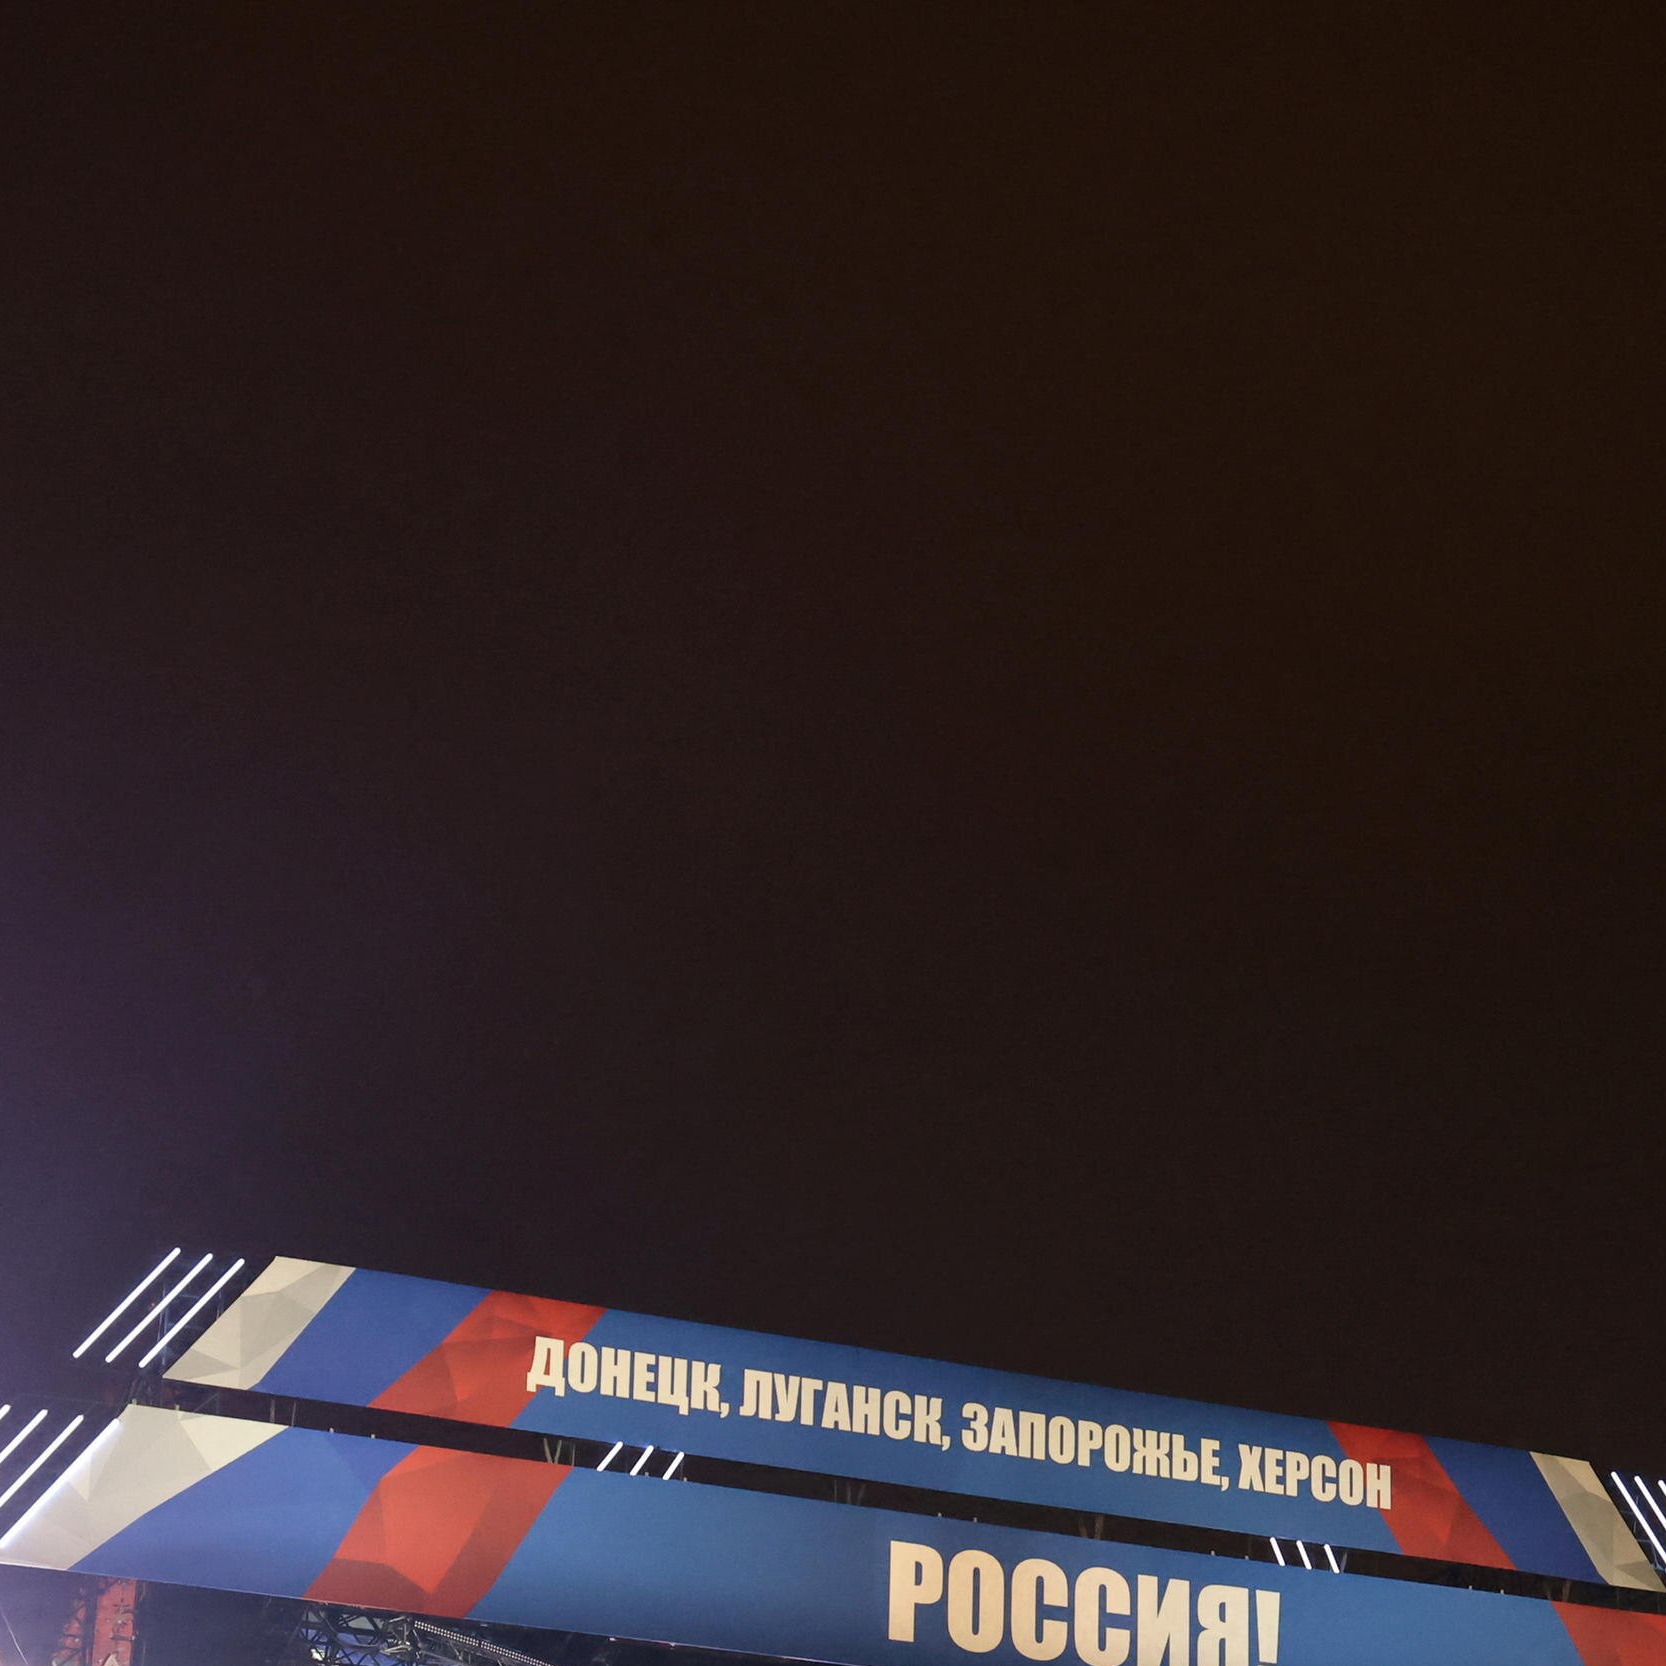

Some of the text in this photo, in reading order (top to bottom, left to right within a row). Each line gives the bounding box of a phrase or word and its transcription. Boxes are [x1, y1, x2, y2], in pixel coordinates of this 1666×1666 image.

[526, 1335, 1392, 1510] ДОНЕЦК, ЛУГАНСК, ЗАПОРОЖЬЕ, ХЕРСОН
